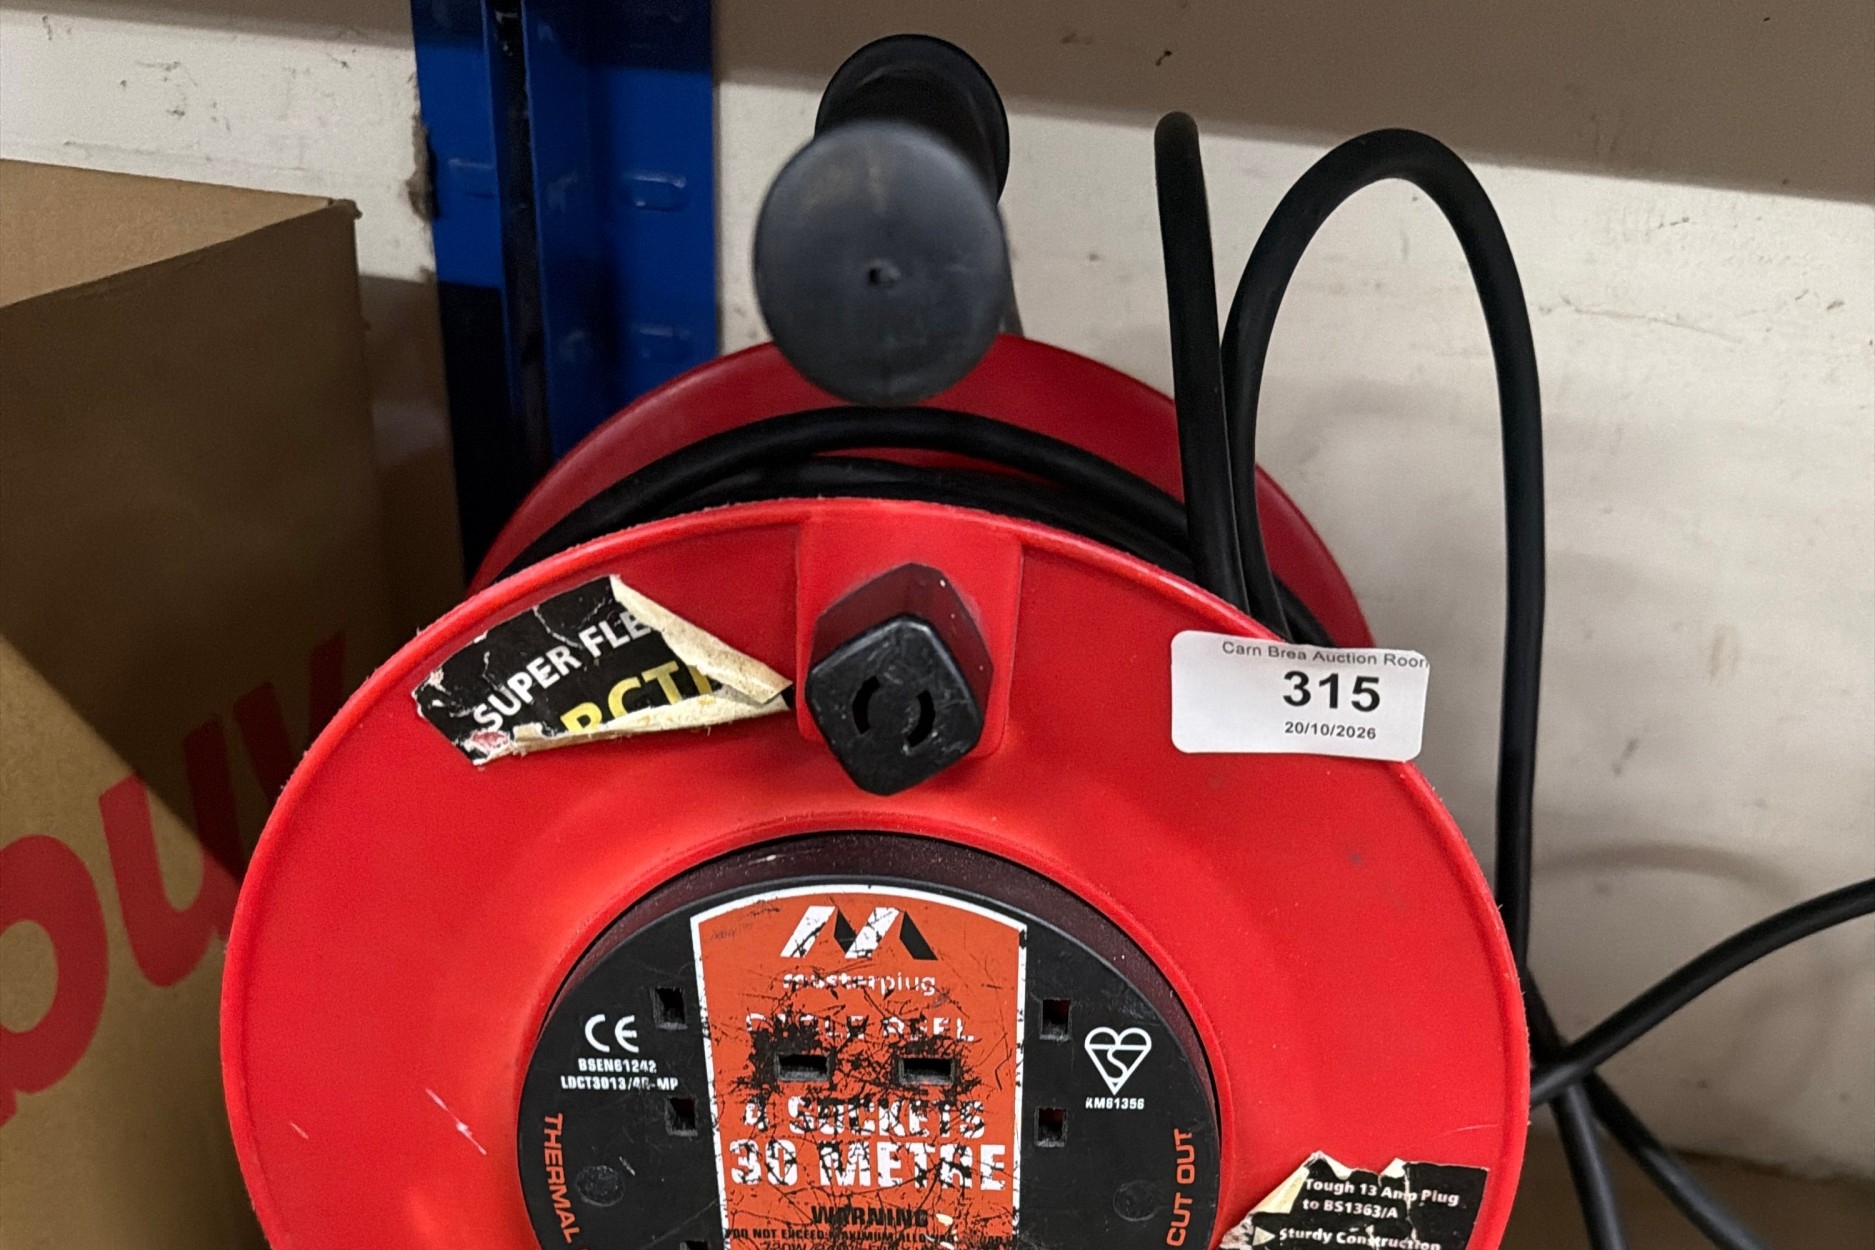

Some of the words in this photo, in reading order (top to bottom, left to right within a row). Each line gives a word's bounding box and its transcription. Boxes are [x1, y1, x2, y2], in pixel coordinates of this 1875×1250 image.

[1222, 641, 1262, 656] Carn
[1268, 645, 1307, 661] Brea
[1312, 650, 1377, 665] Auction
[473, 645, 582, 732] SUPER
[1282, 670, 1381, 712] 315
[1284, 721, 1377, 740] 20/10/2026
[584, 1013, 640, 1053] CE
[578, 1058, 657, 1073] BSEN61242
[787, 1095, 985, 1139] SOCKETS
[1085, 1096, 1145, 1110] KM61356
[729, 1138, 798, 1187] 30
[818, 1140, 1006, 1191] METRE
[1173, 1128, 1196, 1184] OUT
[543, 1112, 581, 1244] THERMAL
[1305, 1178, 1355, 1196] Tough
[1359, 1183, 1378, 1196] 13
[1381, 1187, 1417, 1202] Amp
[1420, 1189, 1460, 1207] Plug
[1166, 1192, 1193, 1247] CUT
[1302, 1198, 1320, 1210] to
[1323, 1201, 1399, 1219] BS1363/A
[753, 1228, 778, 1239] NOT
[781, 1229, 825, 1240] EXCEED
[1279, 1228, 1333, 1245] Sturdy
